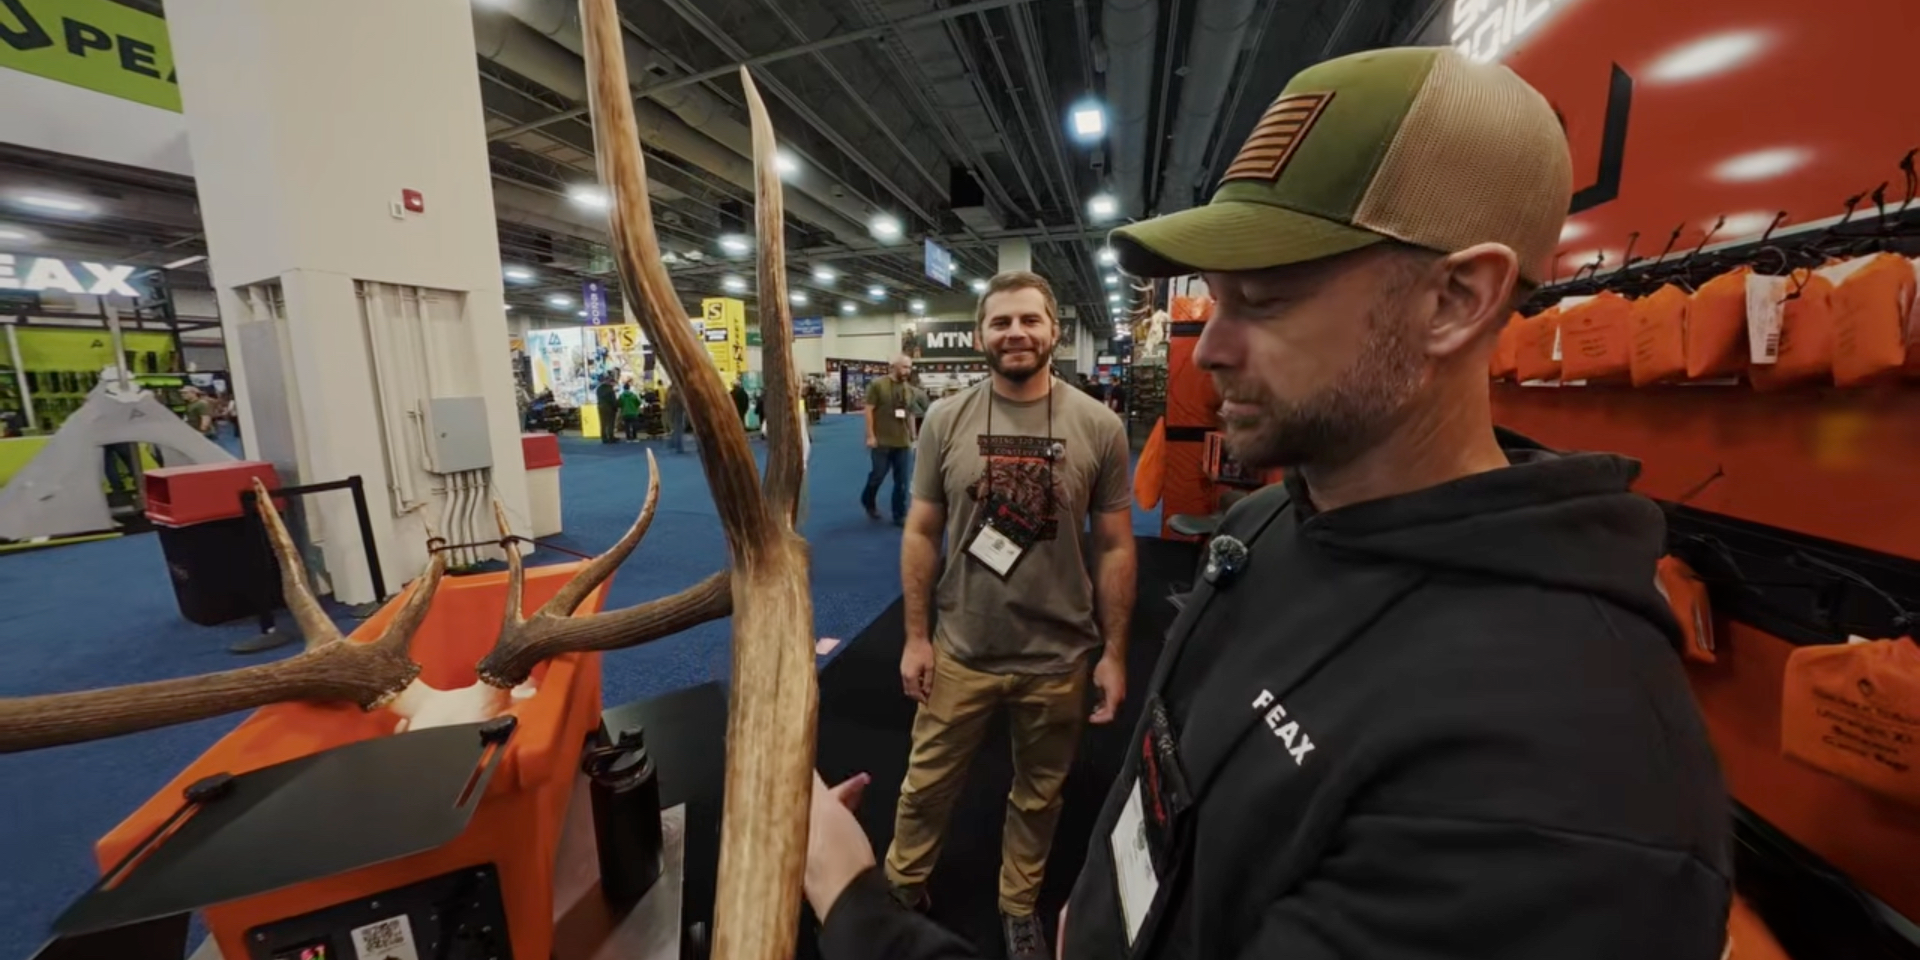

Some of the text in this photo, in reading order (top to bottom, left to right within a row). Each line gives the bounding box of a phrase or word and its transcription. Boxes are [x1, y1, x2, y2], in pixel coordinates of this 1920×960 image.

[62, 16, 178, 85] PE
[926, 331, 973, 349] MTN
[1252, 688, 1316, 766] PEAX
